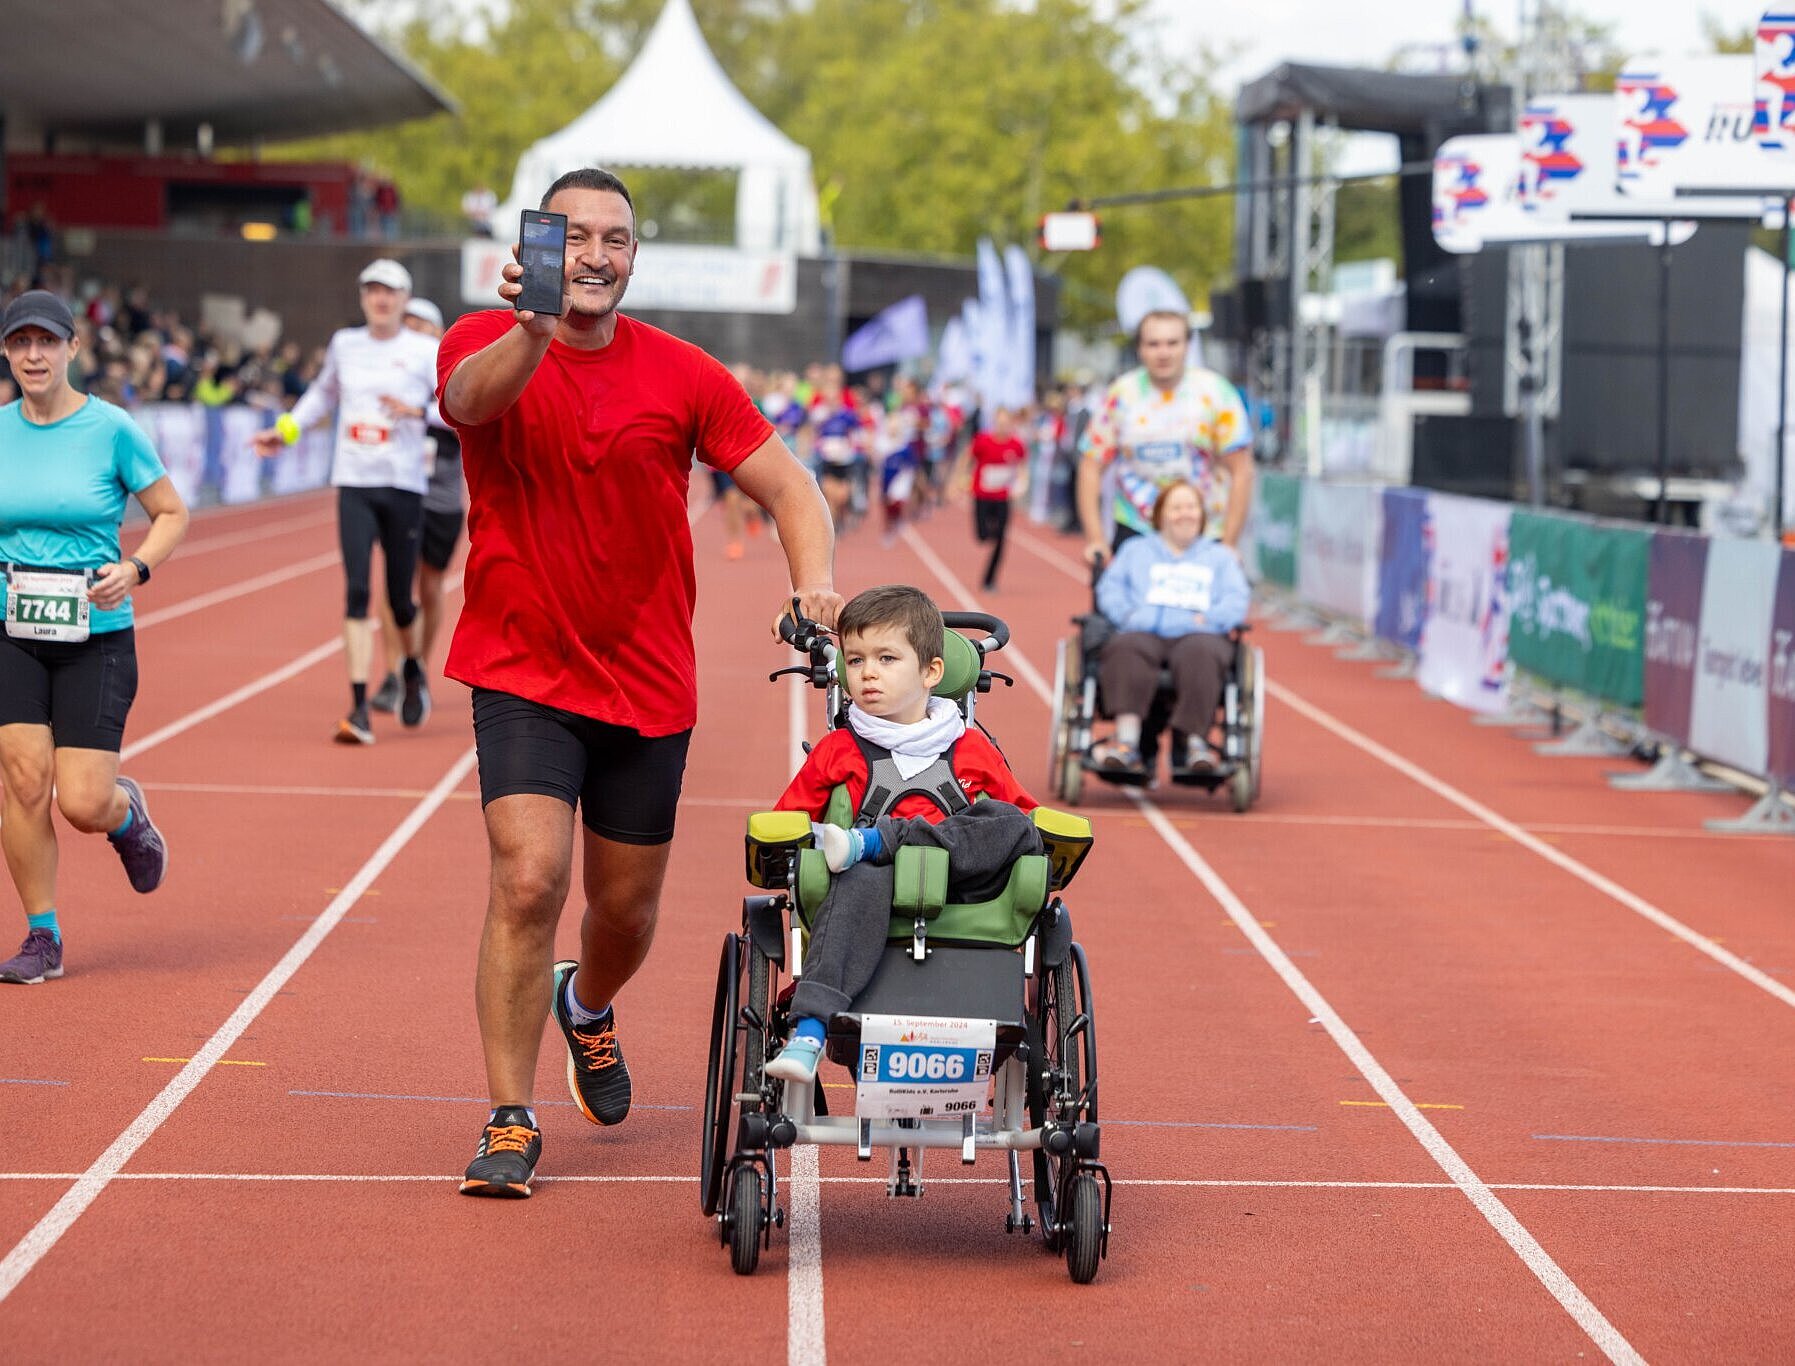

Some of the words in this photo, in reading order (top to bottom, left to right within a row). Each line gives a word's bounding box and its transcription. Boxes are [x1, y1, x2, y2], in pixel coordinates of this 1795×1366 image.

[1704, 116, 1754, 143] RU
[21, 599, 71, 621] 7744
[34, 626, 57, 635] Laura
[906, 1019, 947, 1029] September
[888, 1051, 964, 1079] 9066
[945, 1100, 976, 1112] 9066
